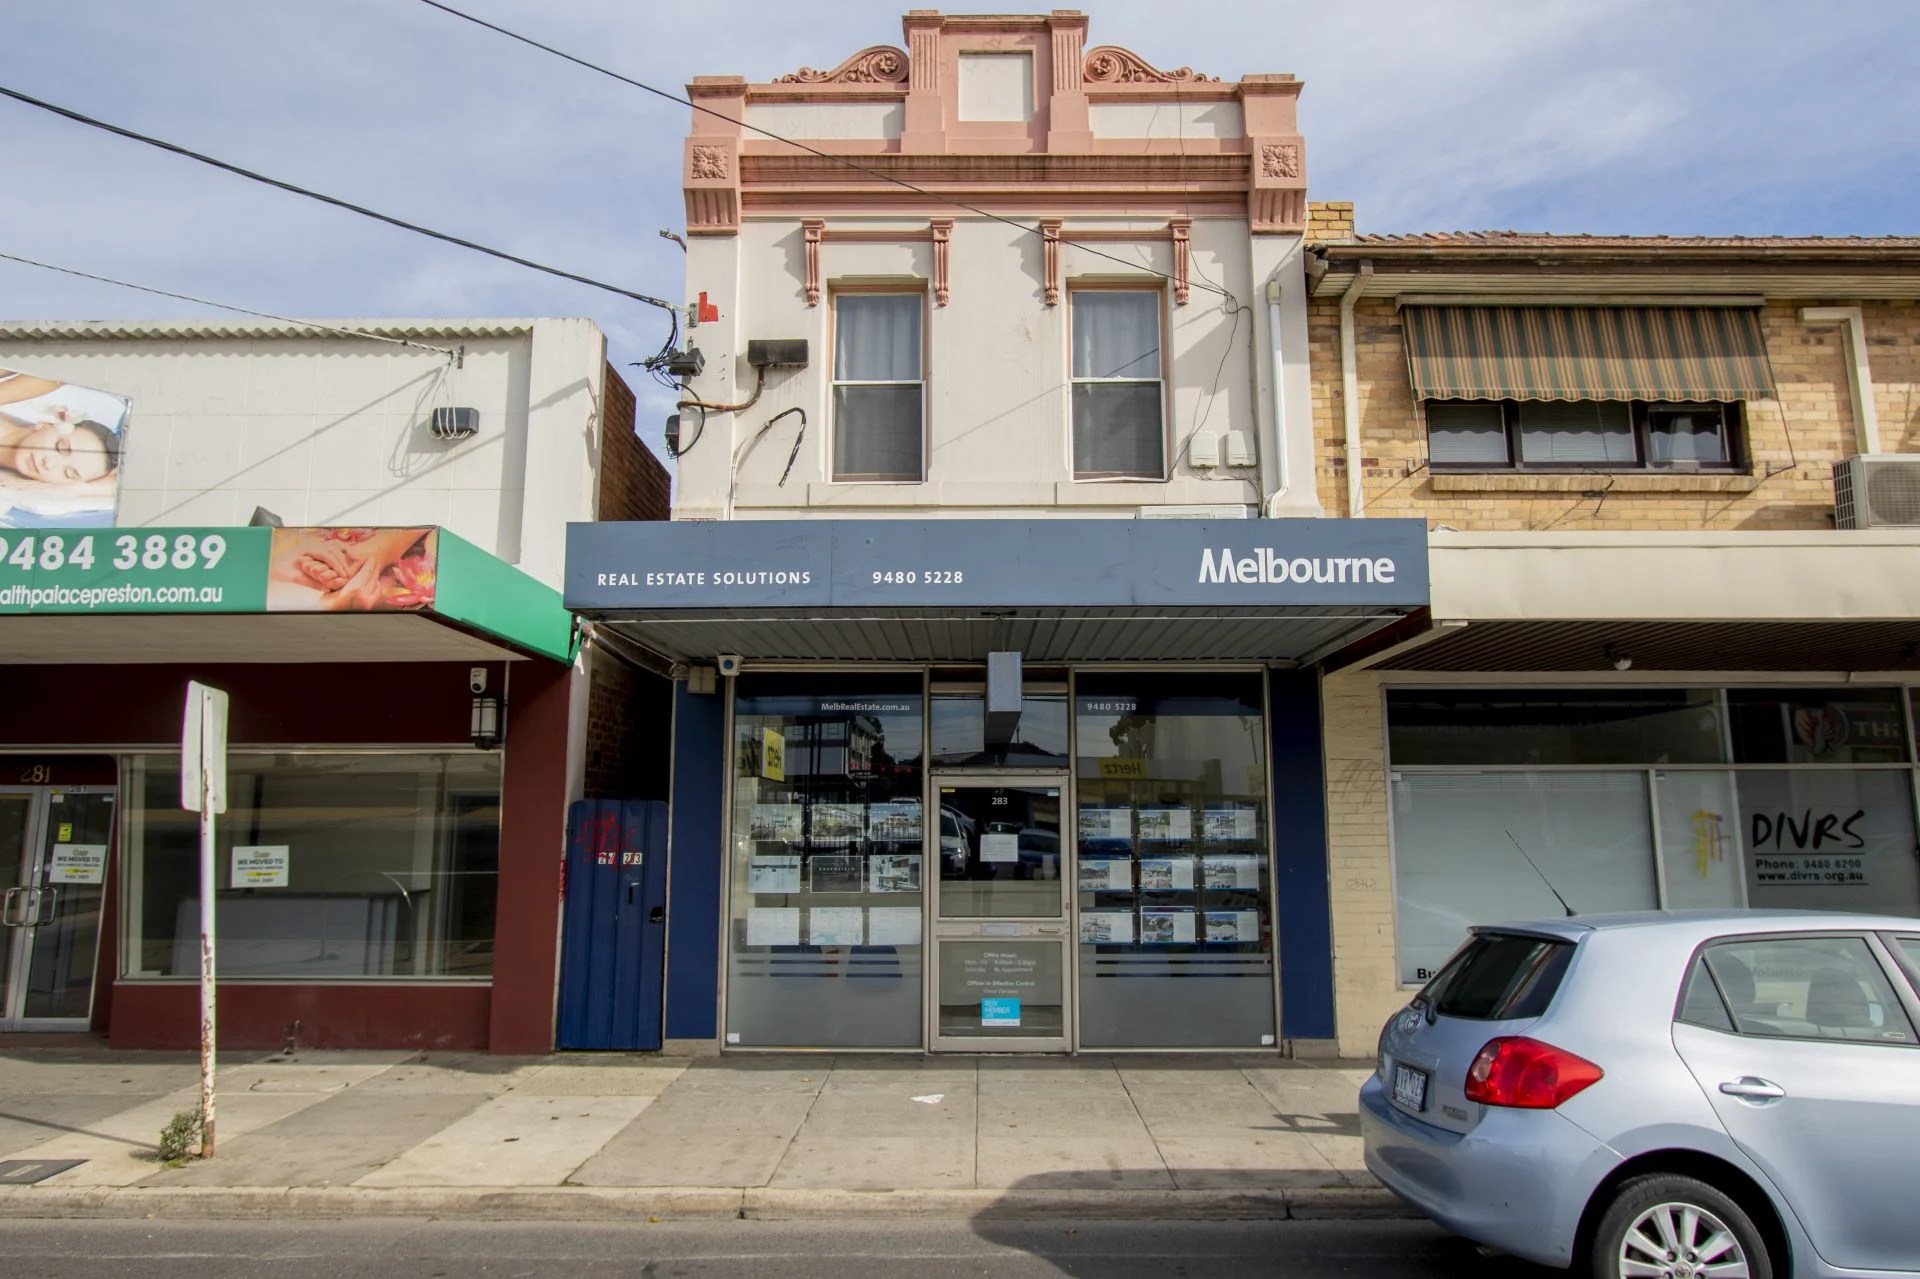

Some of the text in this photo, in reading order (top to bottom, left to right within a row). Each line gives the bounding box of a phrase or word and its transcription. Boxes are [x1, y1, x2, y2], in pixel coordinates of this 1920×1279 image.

[113, 534, 227, 570] 3889
[1198, 547, 1396, 584] Melbourne
[597, 571, 811, 586] REAL ESTATE SOLUTIONS
[872, 571, 963, 584] 9480 5228
[821, 702, 910, 711] MelbRealEstate.com.au
[1087, 703, 1137, 711] 9480 5228
[20, 764, 52, 783] 281
[70, 785, 87, 793] 281
[991, 797, 1008, 805] 283
[1752, 808, 1865, 850] DIVRS
[623, 852, 642, 864] 283
[1755, 858, 1800, 869] Phone:
[1756, 871, 1864, 882] www.divrs.org.au
